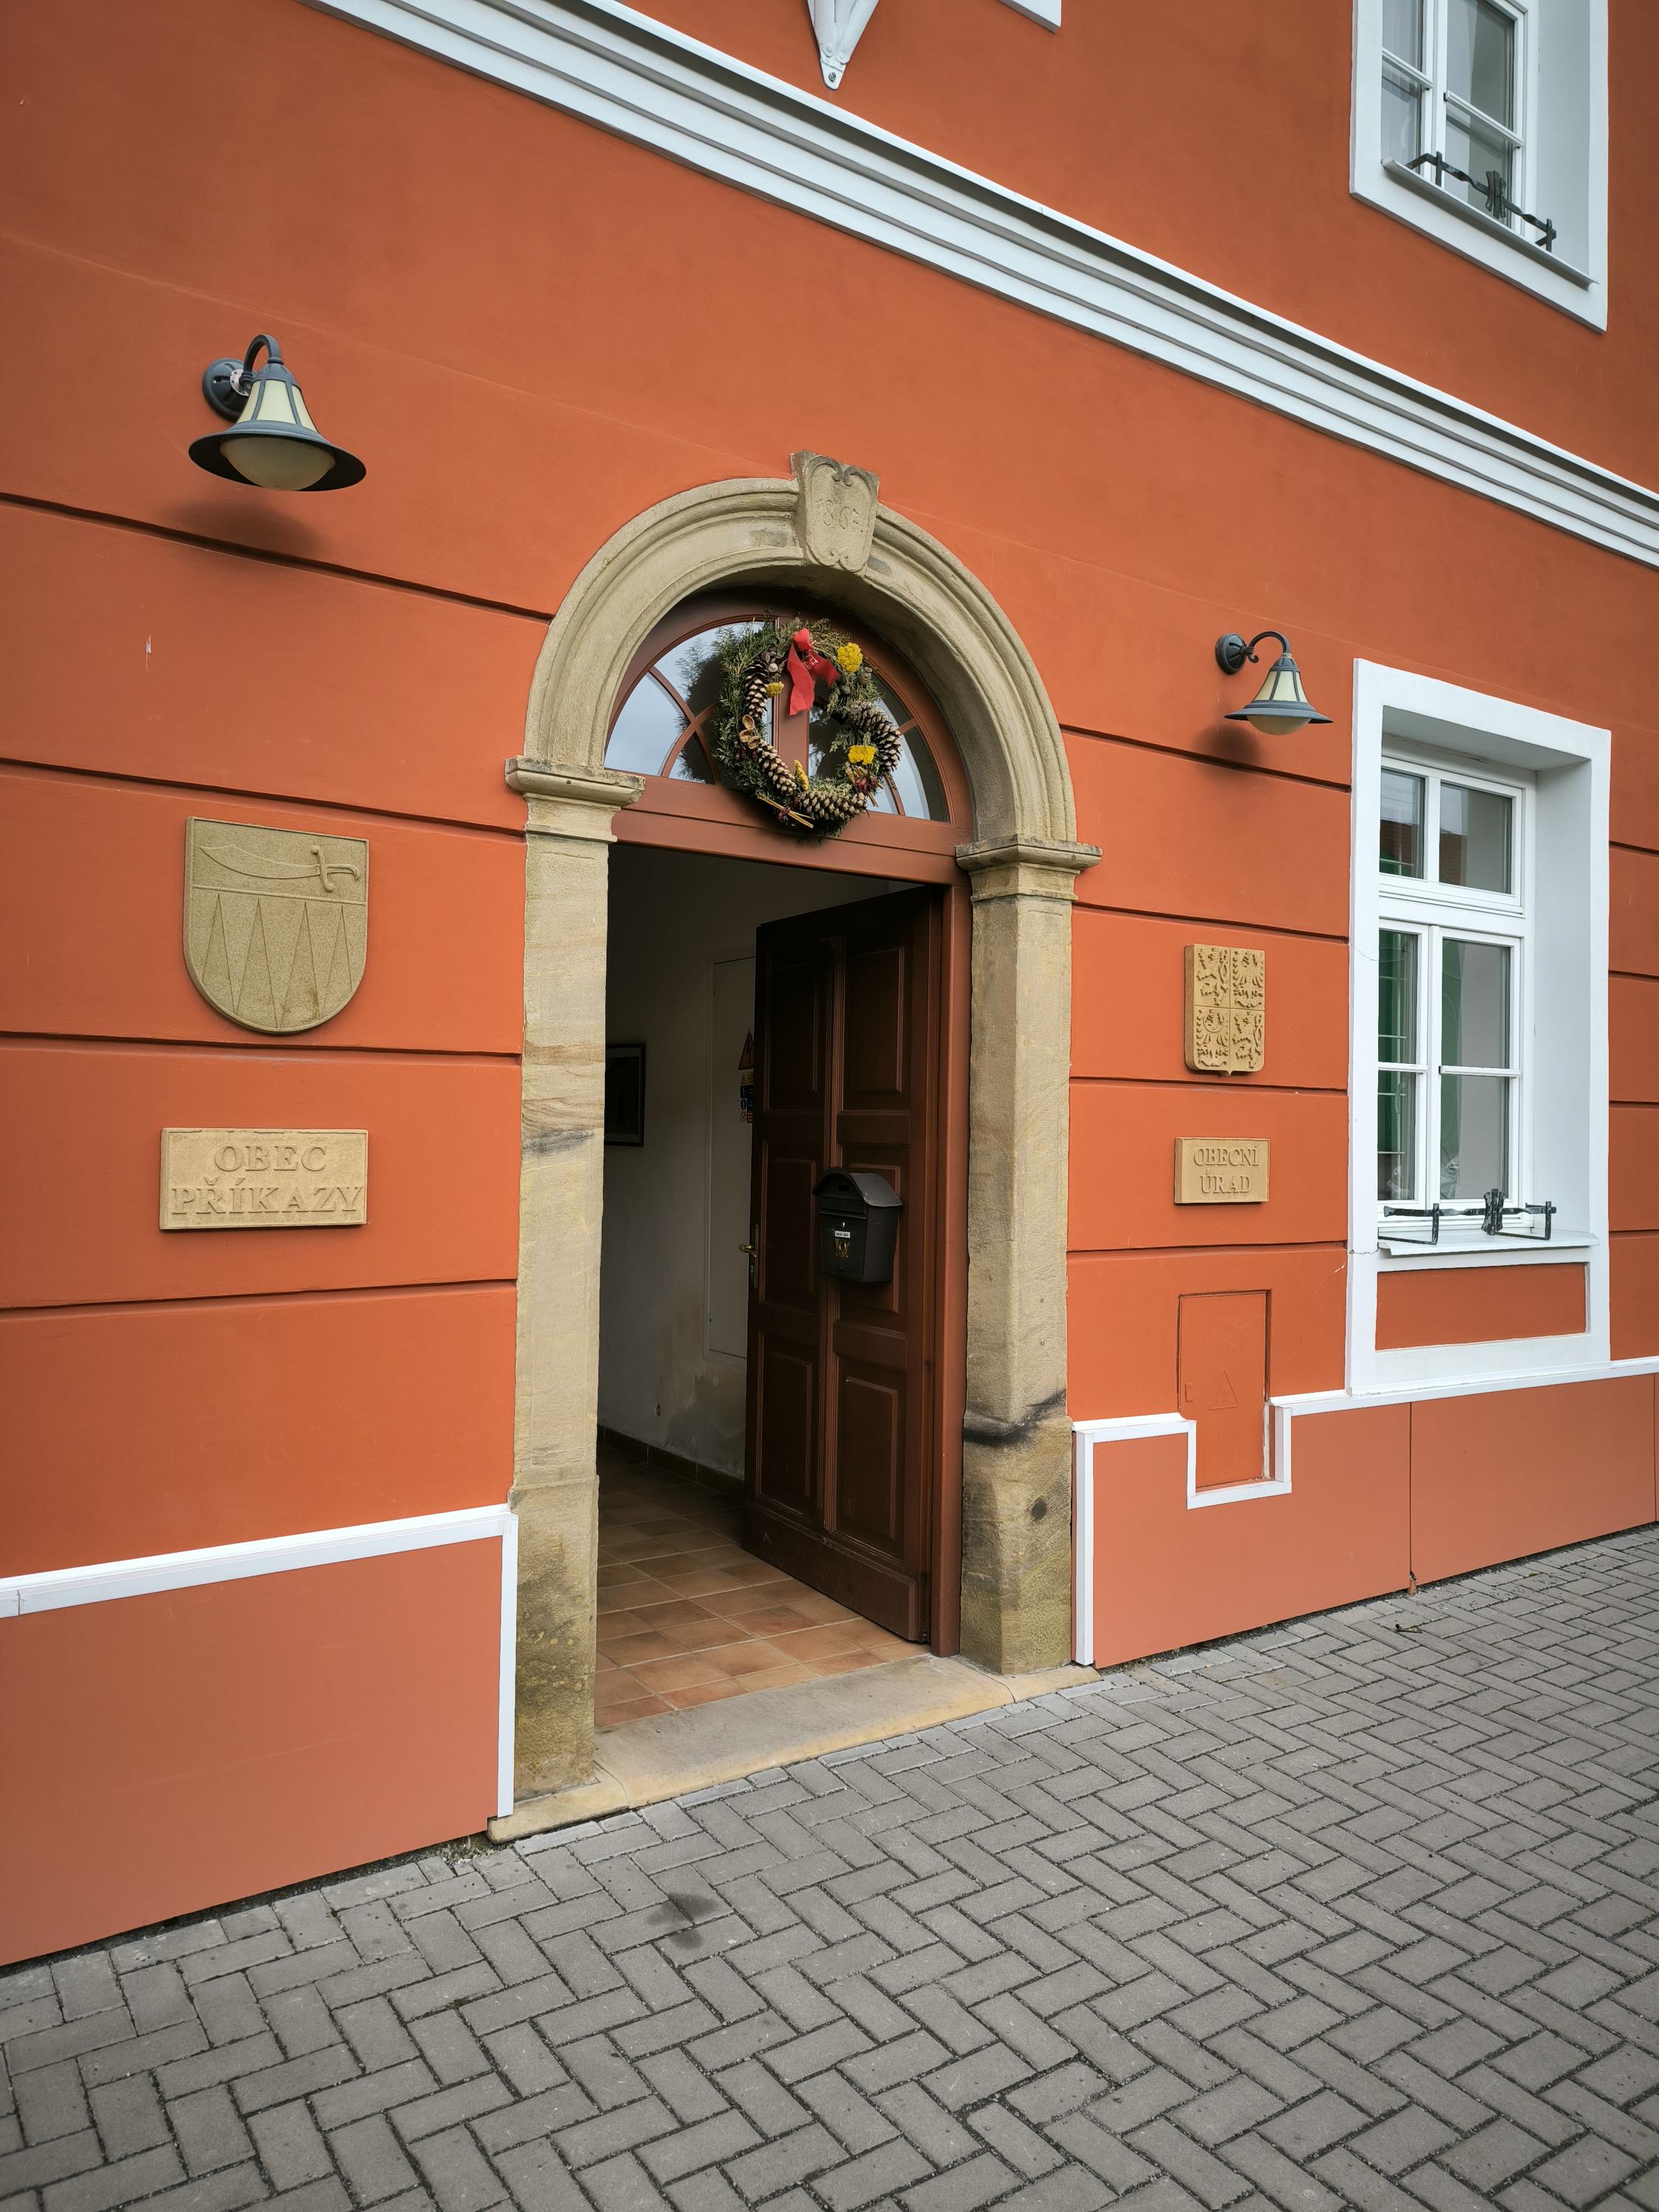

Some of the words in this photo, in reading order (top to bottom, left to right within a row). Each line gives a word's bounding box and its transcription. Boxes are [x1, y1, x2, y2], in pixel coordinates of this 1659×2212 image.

[214, 1144, 327, 1172] OBEC
[1193, 1142, 1261, 1166] OBECNÍ
[171, 1176, 364, 1214] PŘÍKAZY
